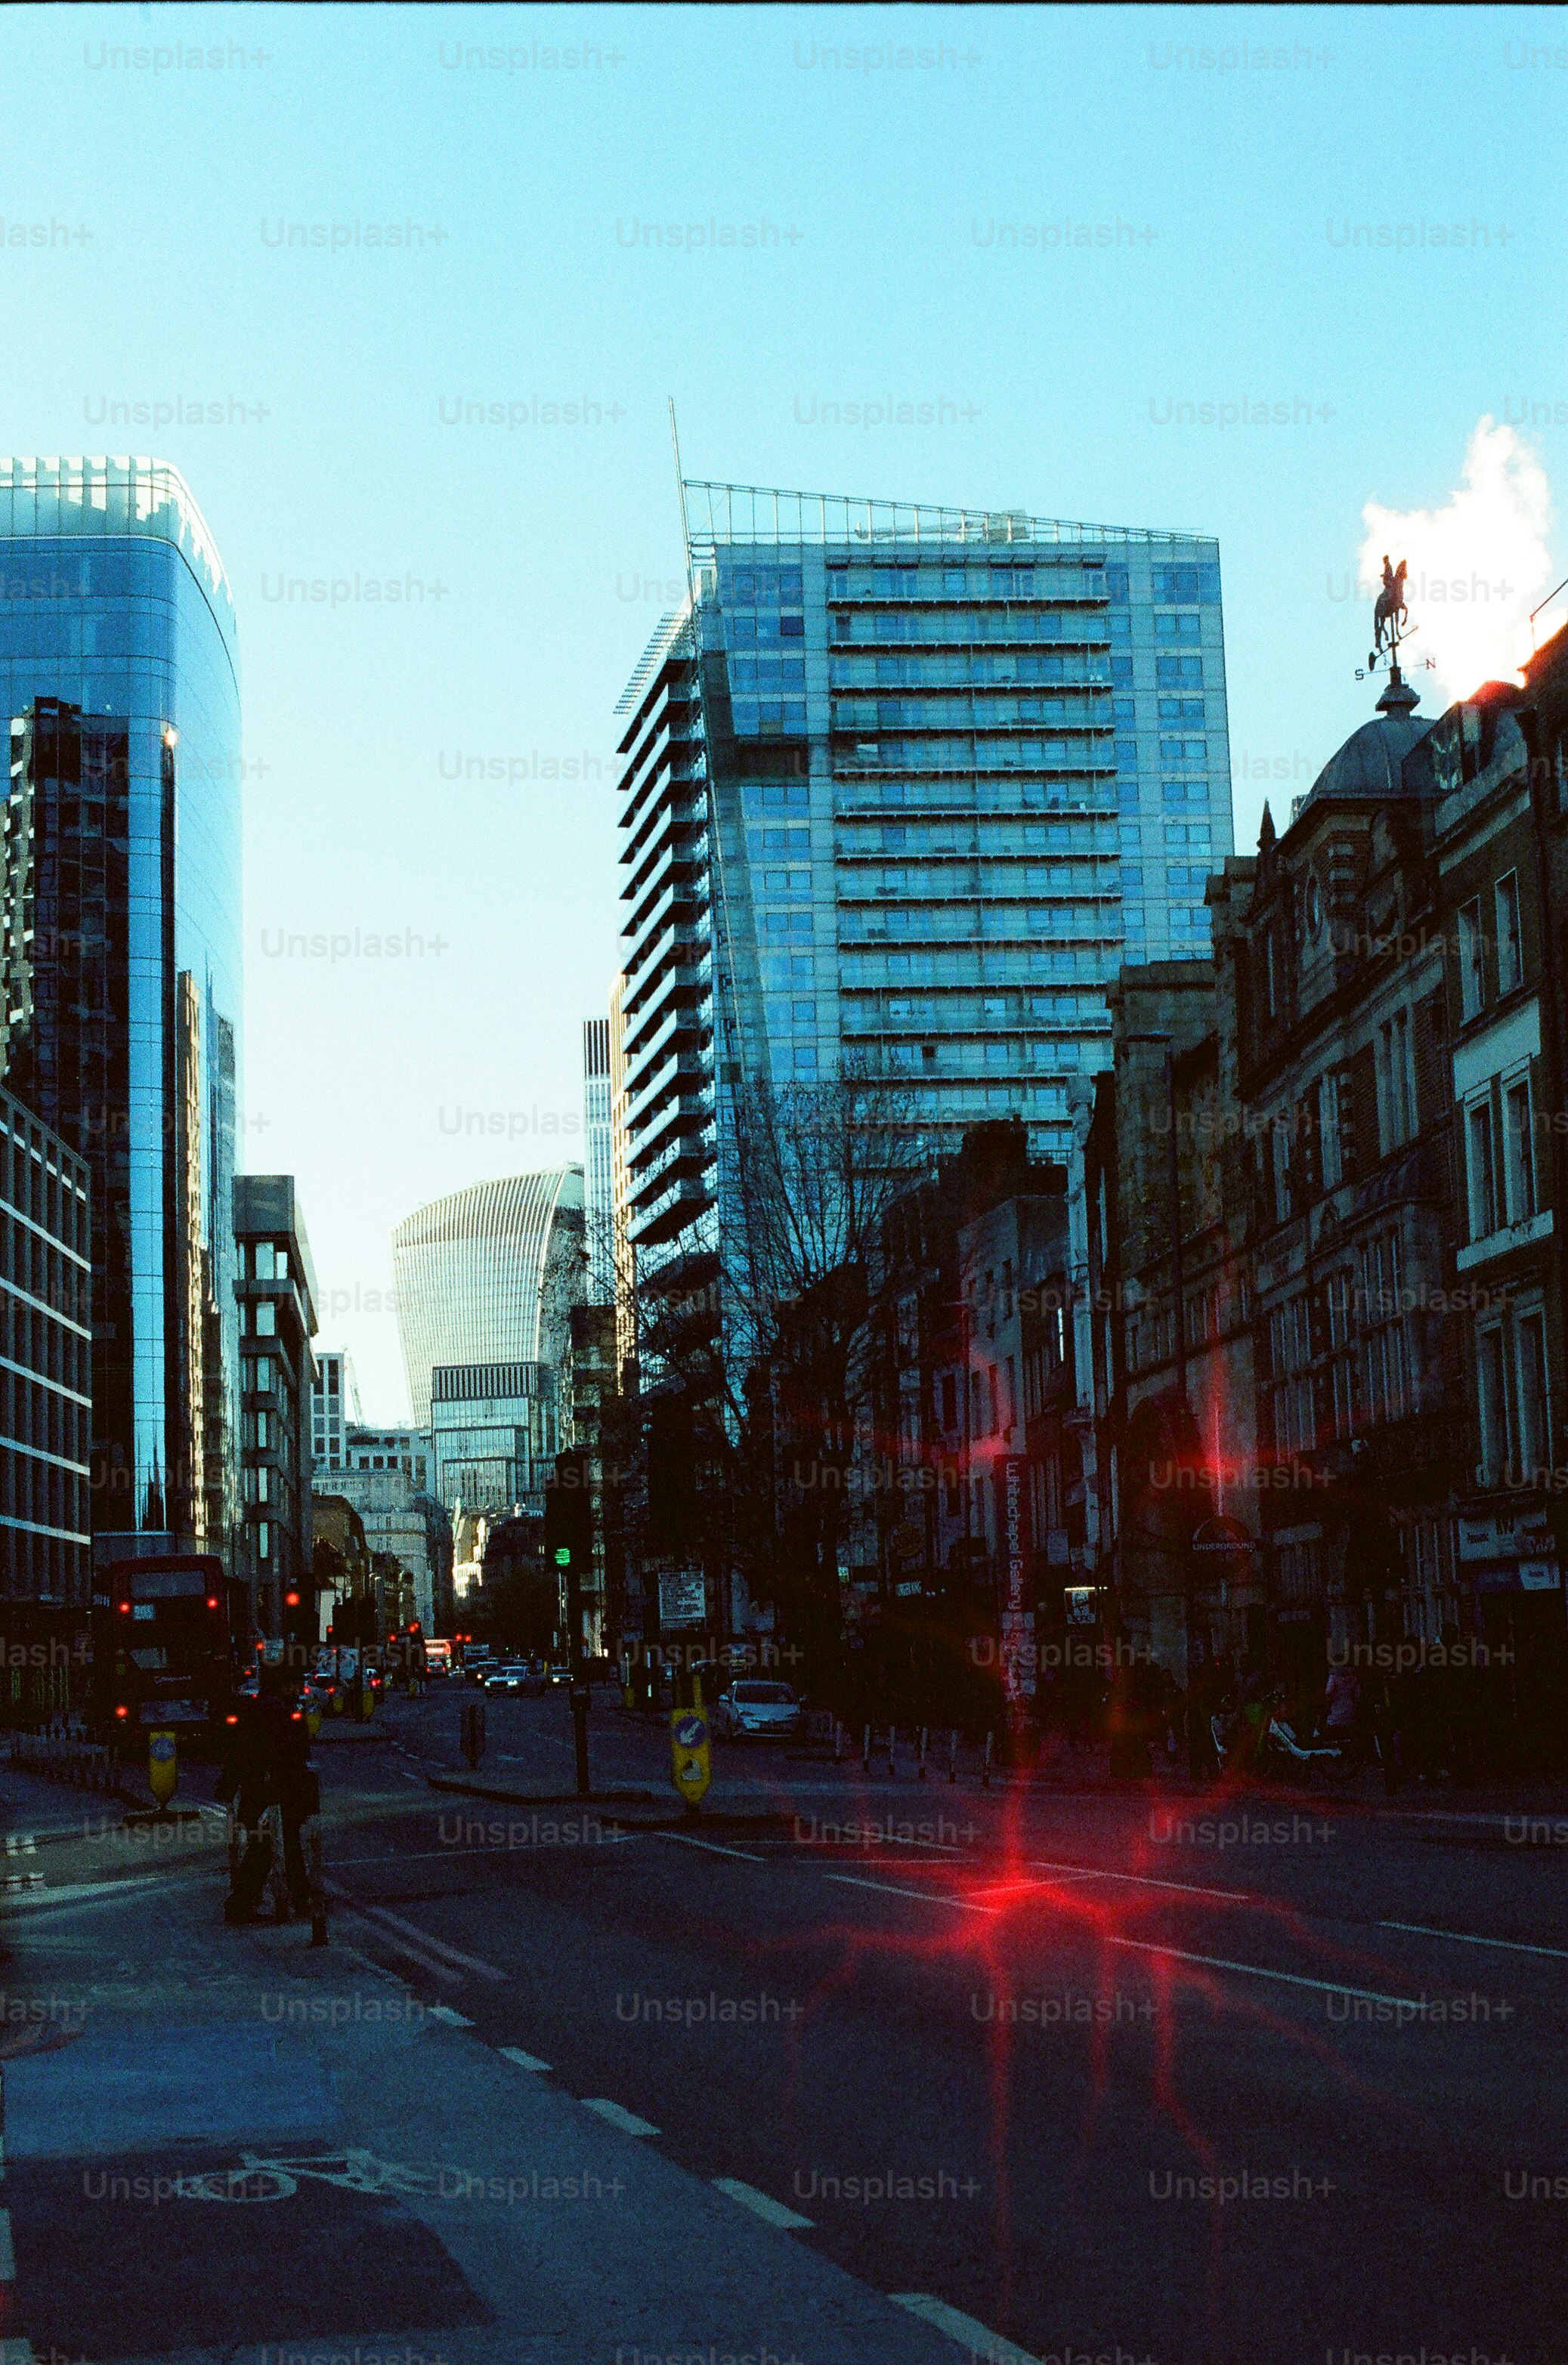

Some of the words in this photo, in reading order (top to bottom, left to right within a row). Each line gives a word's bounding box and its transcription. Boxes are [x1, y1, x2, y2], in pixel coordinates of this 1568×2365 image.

[1426, 657, 1436, 669] N
[1355, 669, 1365, 681] S
[1006, 1461, 1022, 1554] Whitechapel
[1192, 1541, 1256, 1550] UNDERGROUND
[1007, 1559, 1024, 1611] Gallery
